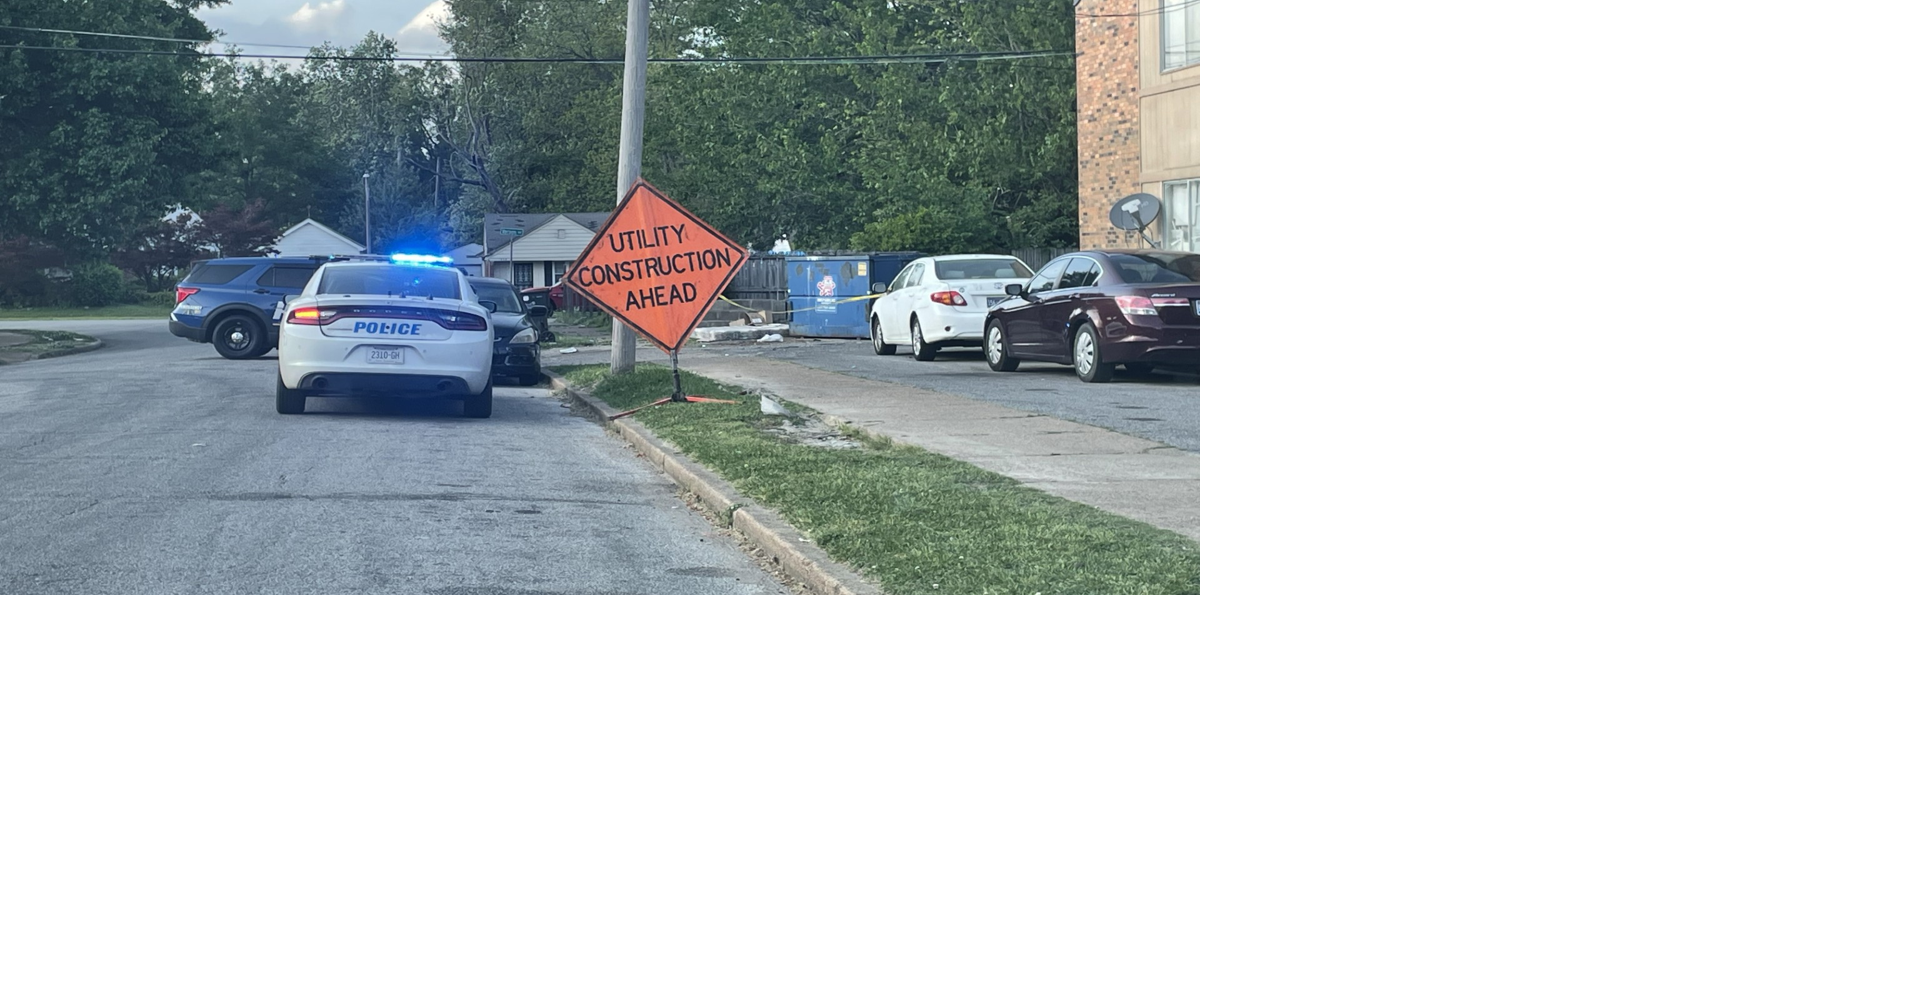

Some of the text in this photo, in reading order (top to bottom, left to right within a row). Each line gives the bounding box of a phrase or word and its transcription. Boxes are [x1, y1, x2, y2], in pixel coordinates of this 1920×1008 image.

[609, 223, 685, 253] UTILITY
[578, 247, 731, 287] CONSTRUCTION
[626, 282, 697, 311] AHEAD
[353, 321, 422, 335] POLICE
[371, 350, 400, 359] 2310-GH
